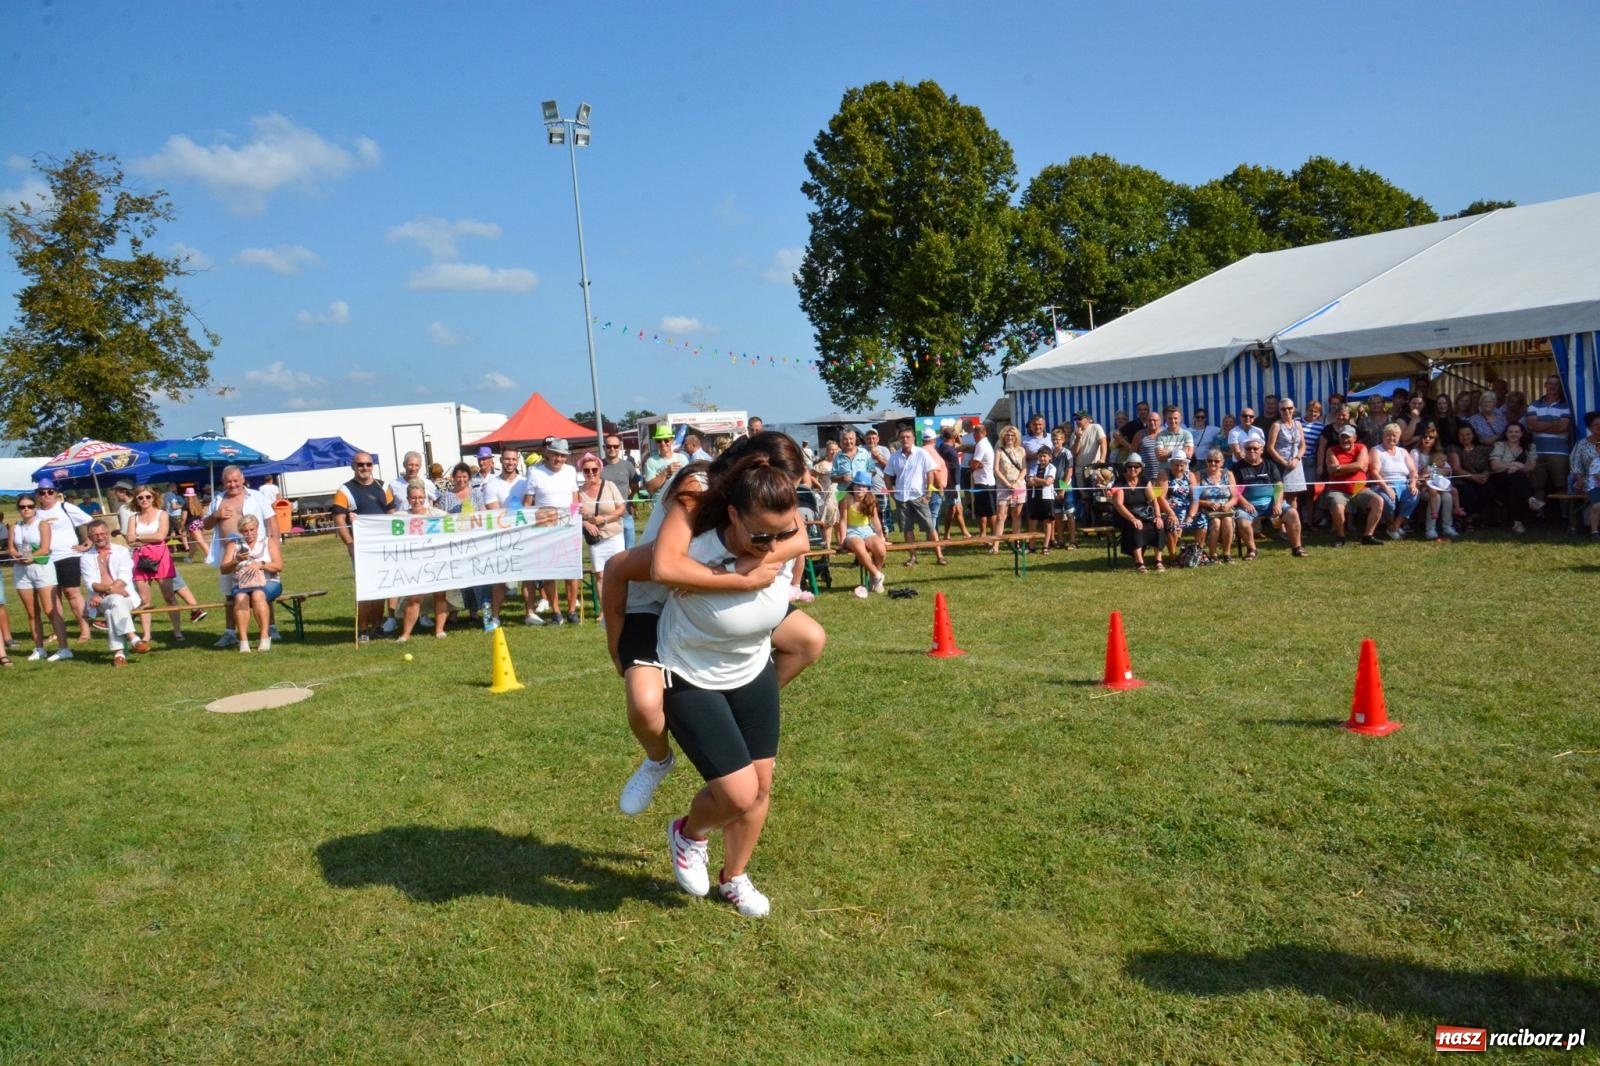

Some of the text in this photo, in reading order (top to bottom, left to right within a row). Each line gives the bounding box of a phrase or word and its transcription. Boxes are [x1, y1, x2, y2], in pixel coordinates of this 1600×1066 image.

[383, 531, 525, 562] WIEŚ NA 102
[377, 559, 464, 590] ZAWSZE
